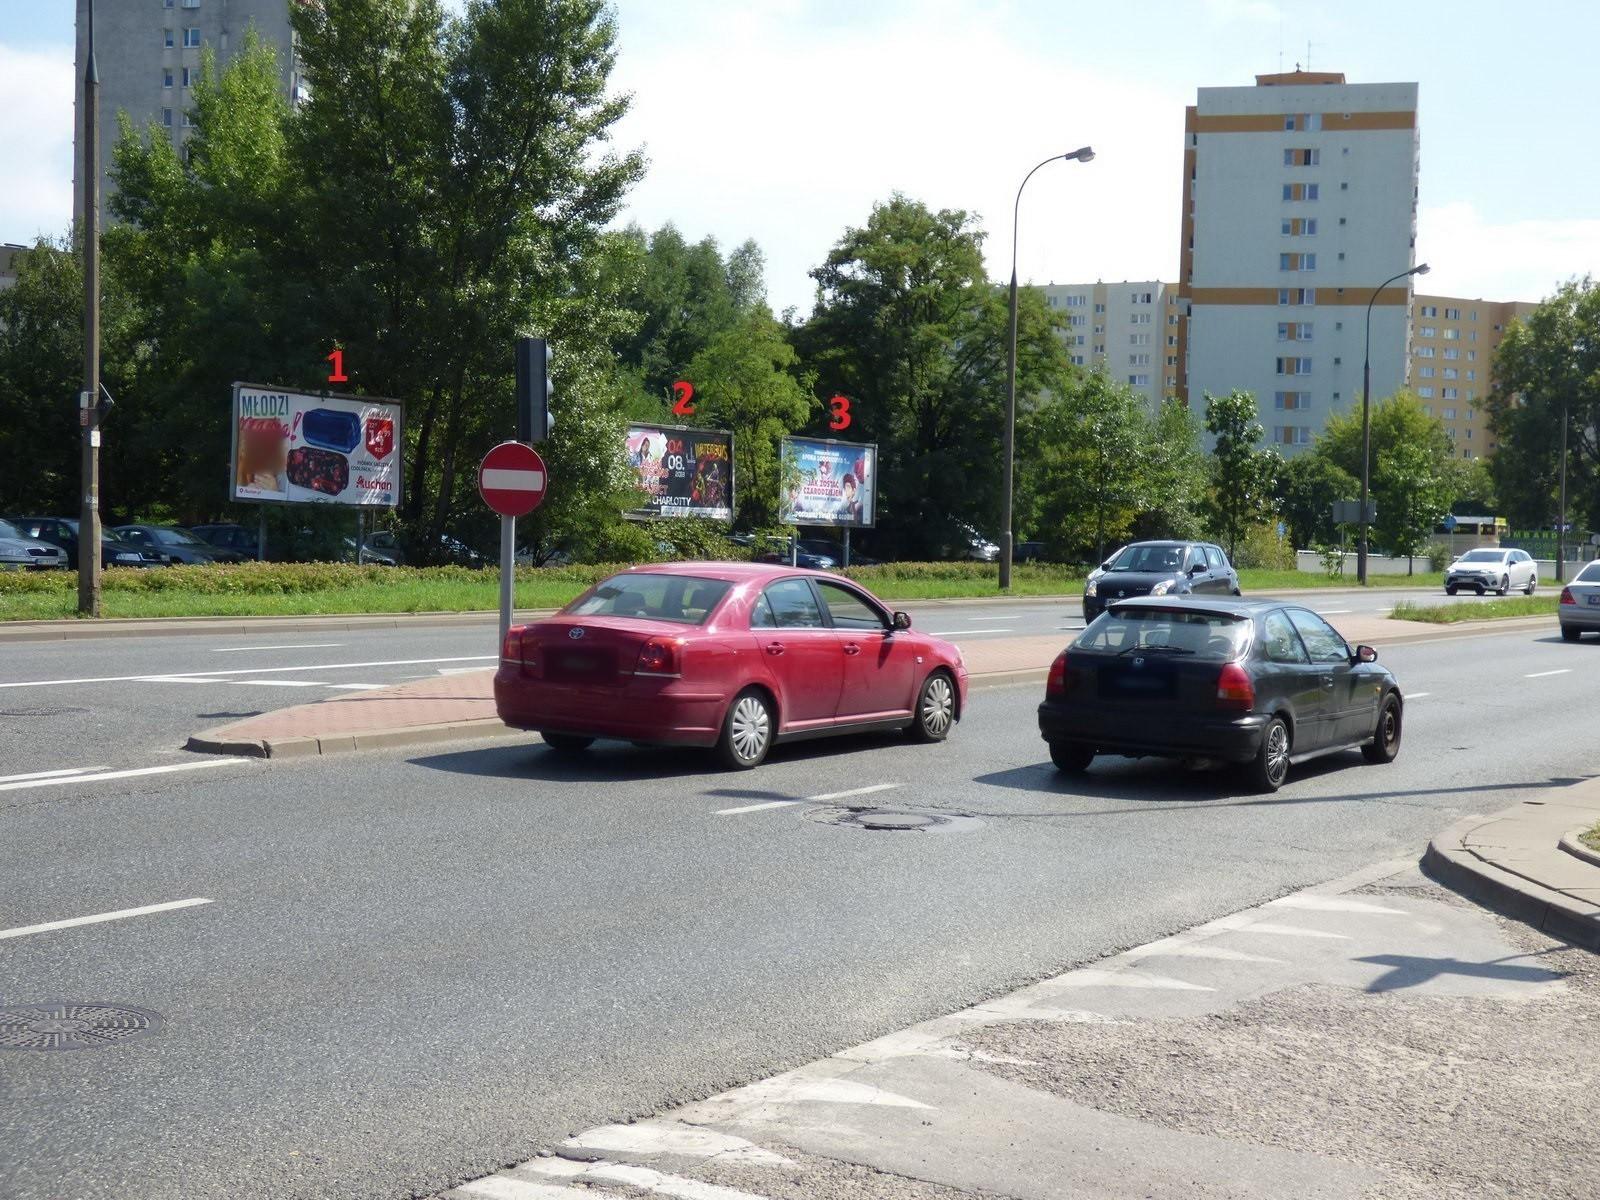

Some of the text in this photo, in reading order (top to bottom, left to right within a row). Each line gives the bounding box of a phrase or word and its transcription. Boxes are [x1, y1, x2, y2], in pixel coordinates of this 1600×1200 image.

[242, 395, 289, 417] MŁODZI
[668, 455, 685, 471] 08.
[355, 475, 392, 491] Auchan
[652, 495, 692, 506] CHARLOTTY
